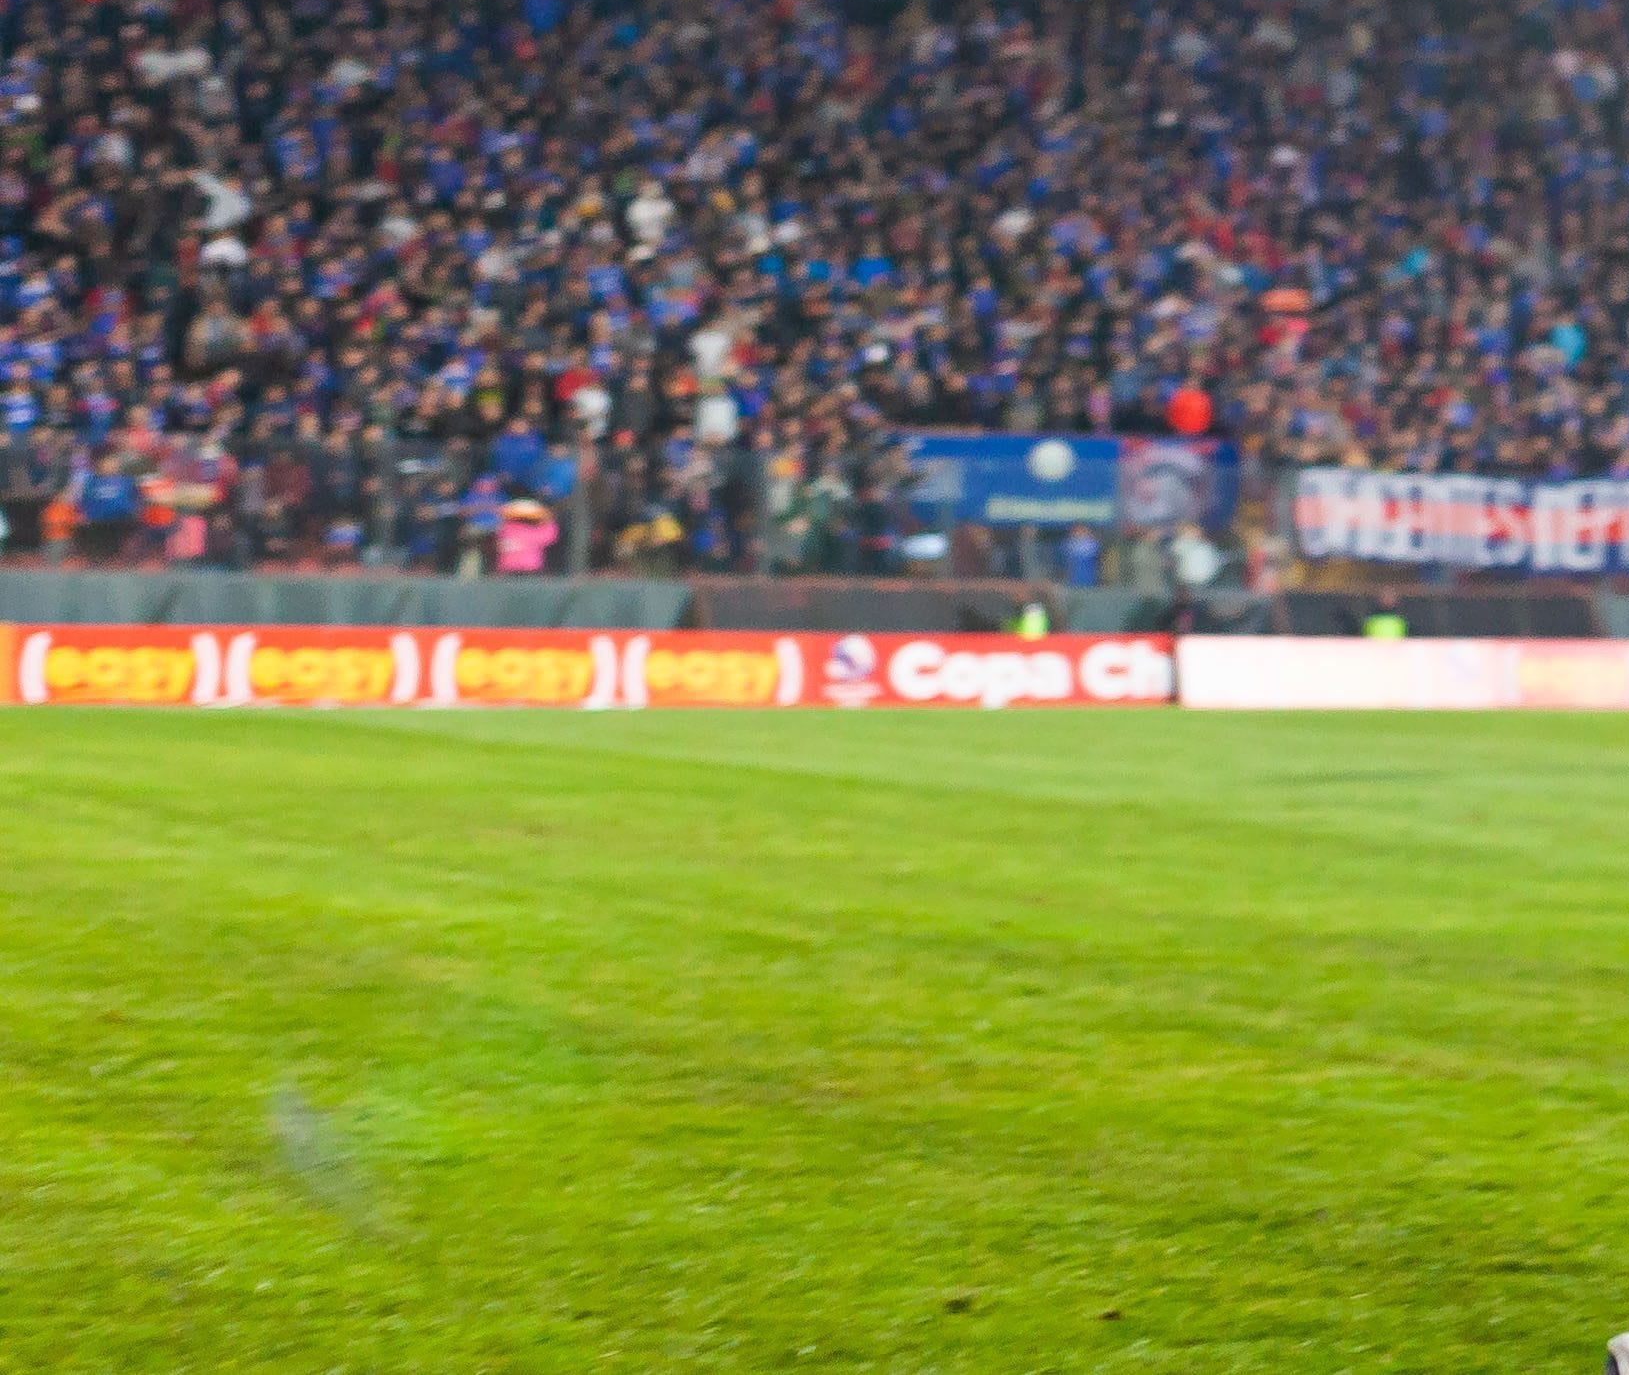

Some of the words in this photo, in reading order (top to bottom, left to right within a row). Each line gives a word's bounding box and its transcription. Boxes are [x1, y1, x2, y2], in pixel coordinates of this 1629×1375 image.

[44, 646, 195, 701] easy
[250, 647, 394, 701] easy
[455, 648, 595, 700] easy
[645, 649, 779, 702] easy
[888, 640, 1073, 710] Copa
